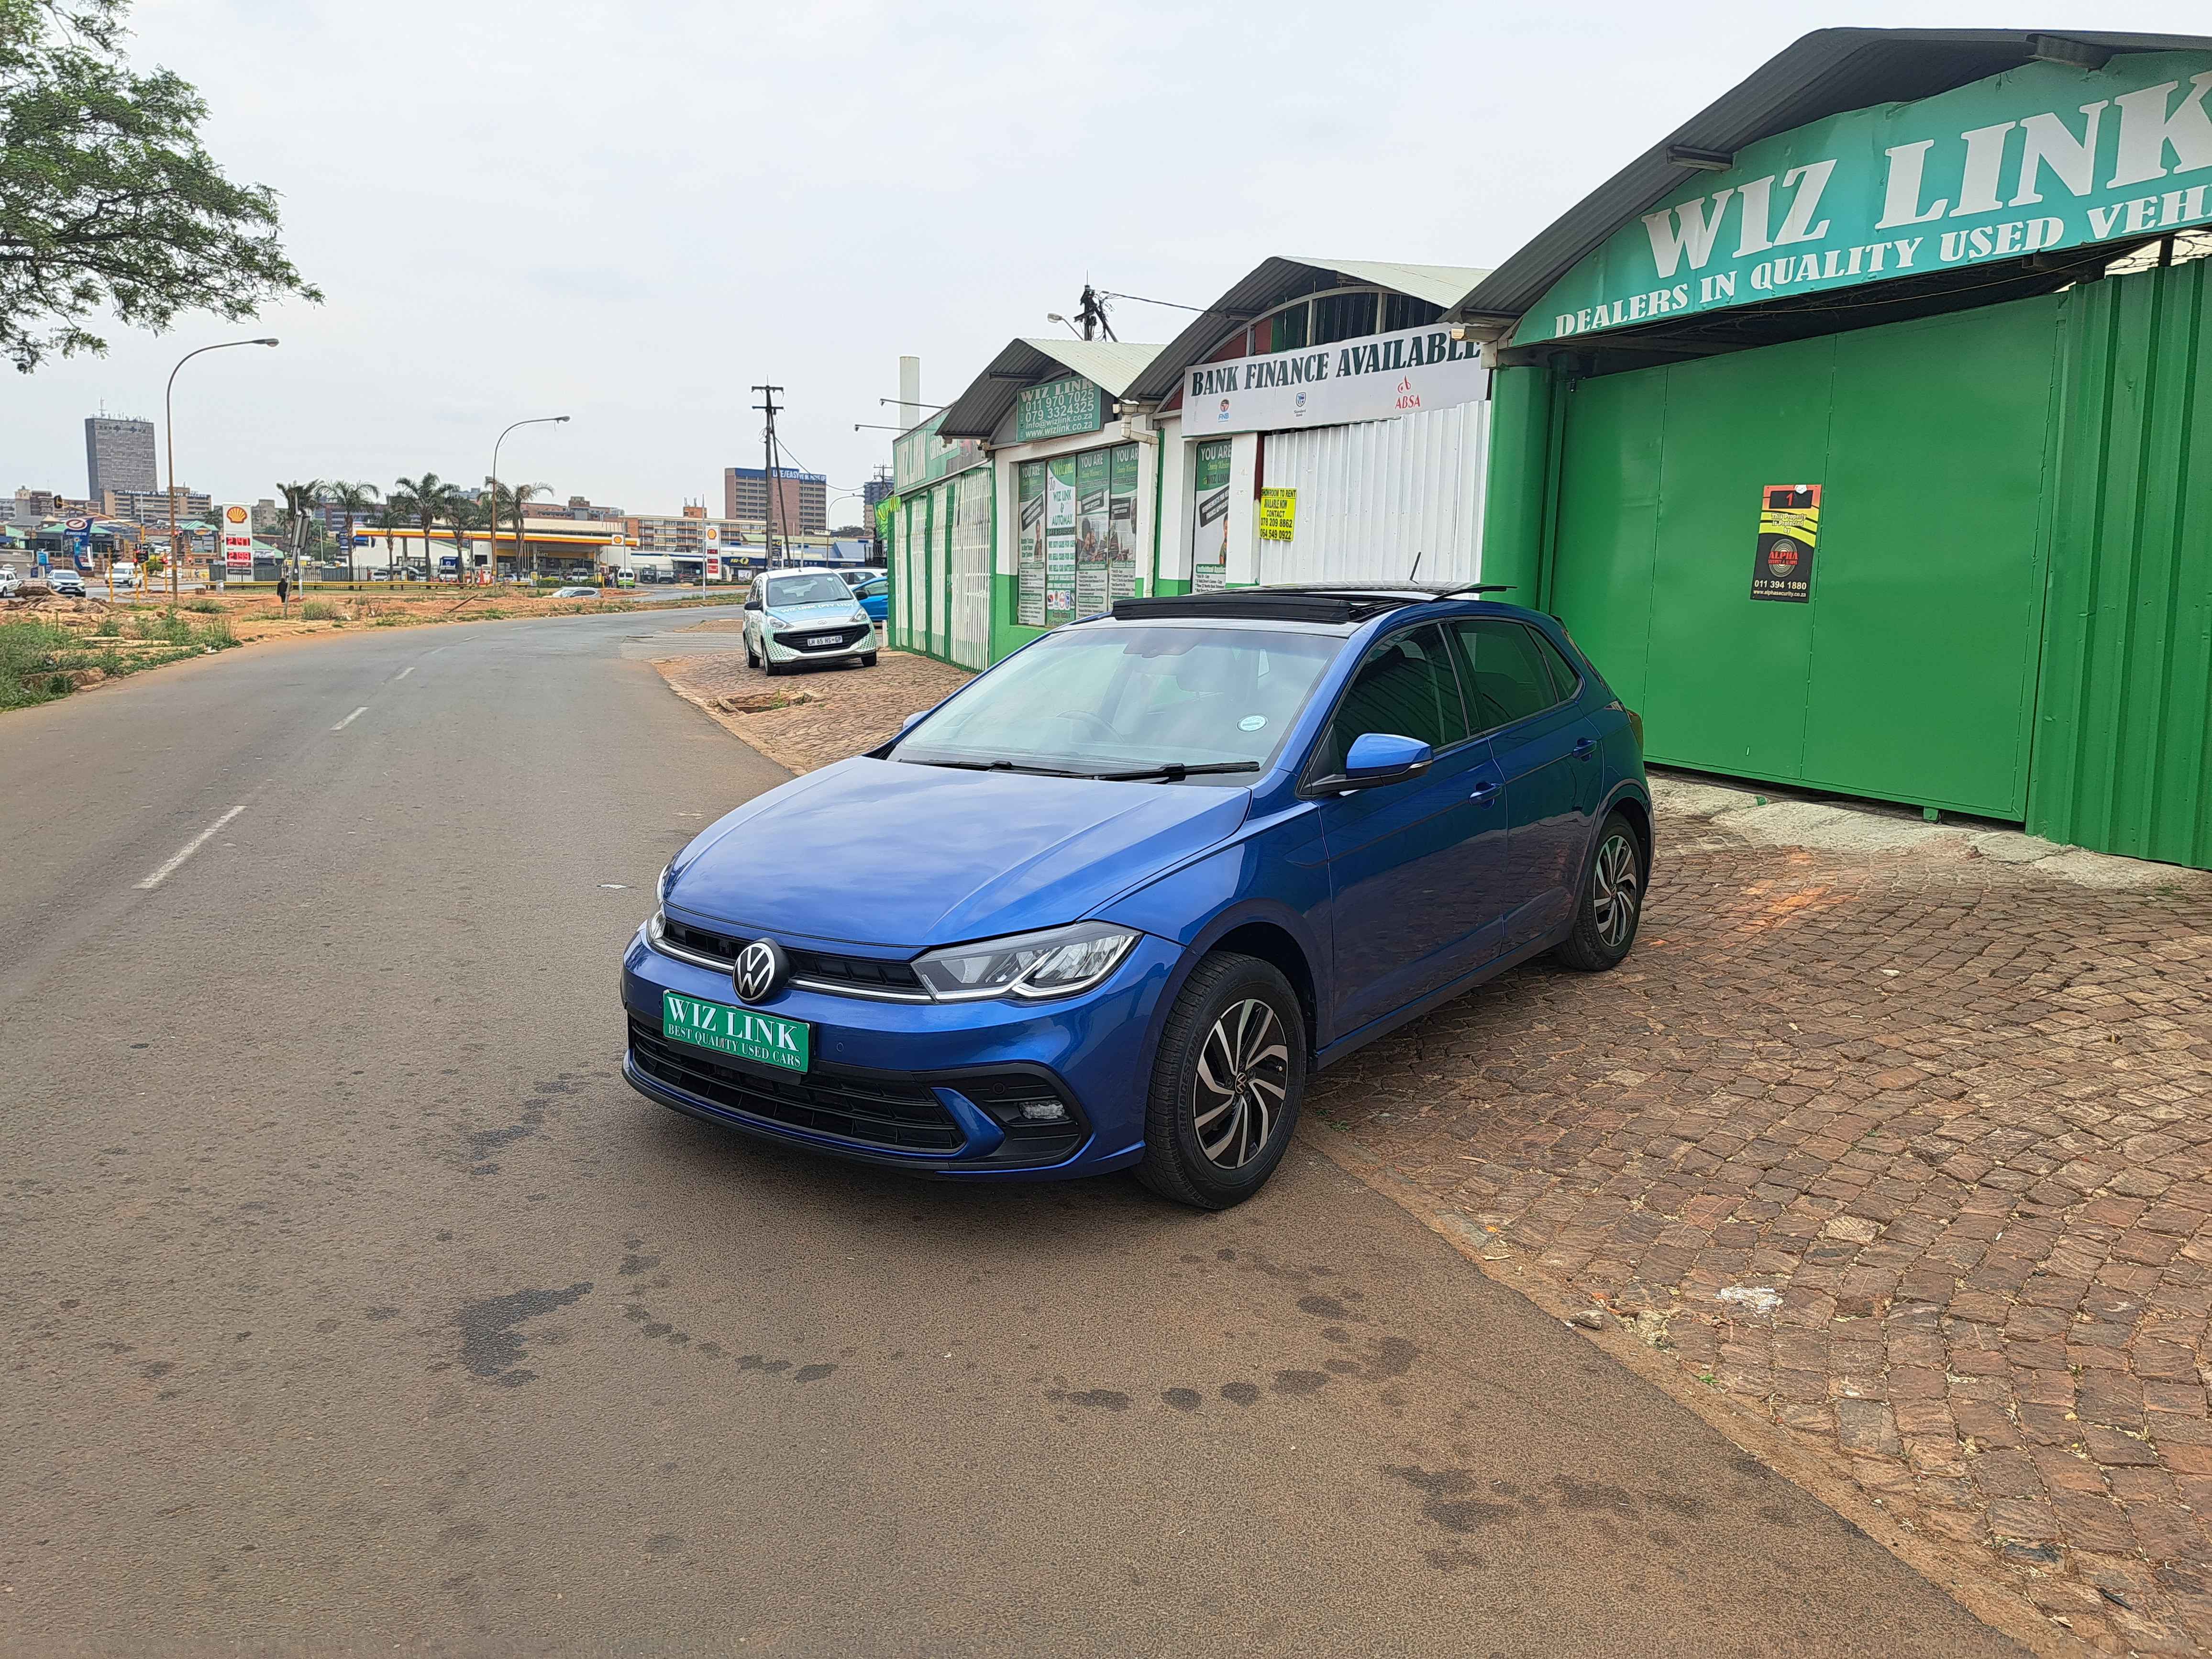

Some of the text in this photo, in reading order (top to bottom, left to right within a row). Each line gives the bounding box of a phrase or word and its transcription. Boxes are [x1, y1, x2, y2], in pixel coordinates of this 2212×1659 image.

[1641, 73, 2212, 279] WIZ LINK
[1555, 183, 2212, 337] DEALERS IN QUALITY USED VEH
[1191, 332, 1481, 397] BANK FINANCE AVAILABLE
[1020, 378, 1095, 402] WIZ LINK
[1026, 388, 1095, 412] 011 970 7025
[1395, 394, 1421, 410] ABSA
[1025, 400, 1095, 422] 079 3324325
[1026, 413, 1093, 430] info@wizlink.co.za
[1025, 421, 1093, 438] www.wizlink.co.za
[1081, 453, 1103, 468] YOU ARE
[1116, 449, 1128, 463] YOU
[1201, 446, 1217, 461] YOU
[1049, 477, 1056, 491] To
[1053, 491, 1062, 502] WIZ
[1786, 492, 1794, 506] 1
[1052, 514, 1073, 526] AUTOMAX
[1269, 518, 1278, 527] 209
[1279, 519, 1293, 528] 8862
[1269, 530, 1278, 539] 549
[1279, 530, 1292, 540] 0922
[1770, 551, 1798, 560] ALPHA
[1754, 580, 1807, 590] 011 394 1880
[1753, 589, 1806, 598] www.alphasecurity.co.za
[667, 996, 799, 1052] WIZ LINK
[669, 1023, 801, 1068] BEST QUALITY USED CARS
